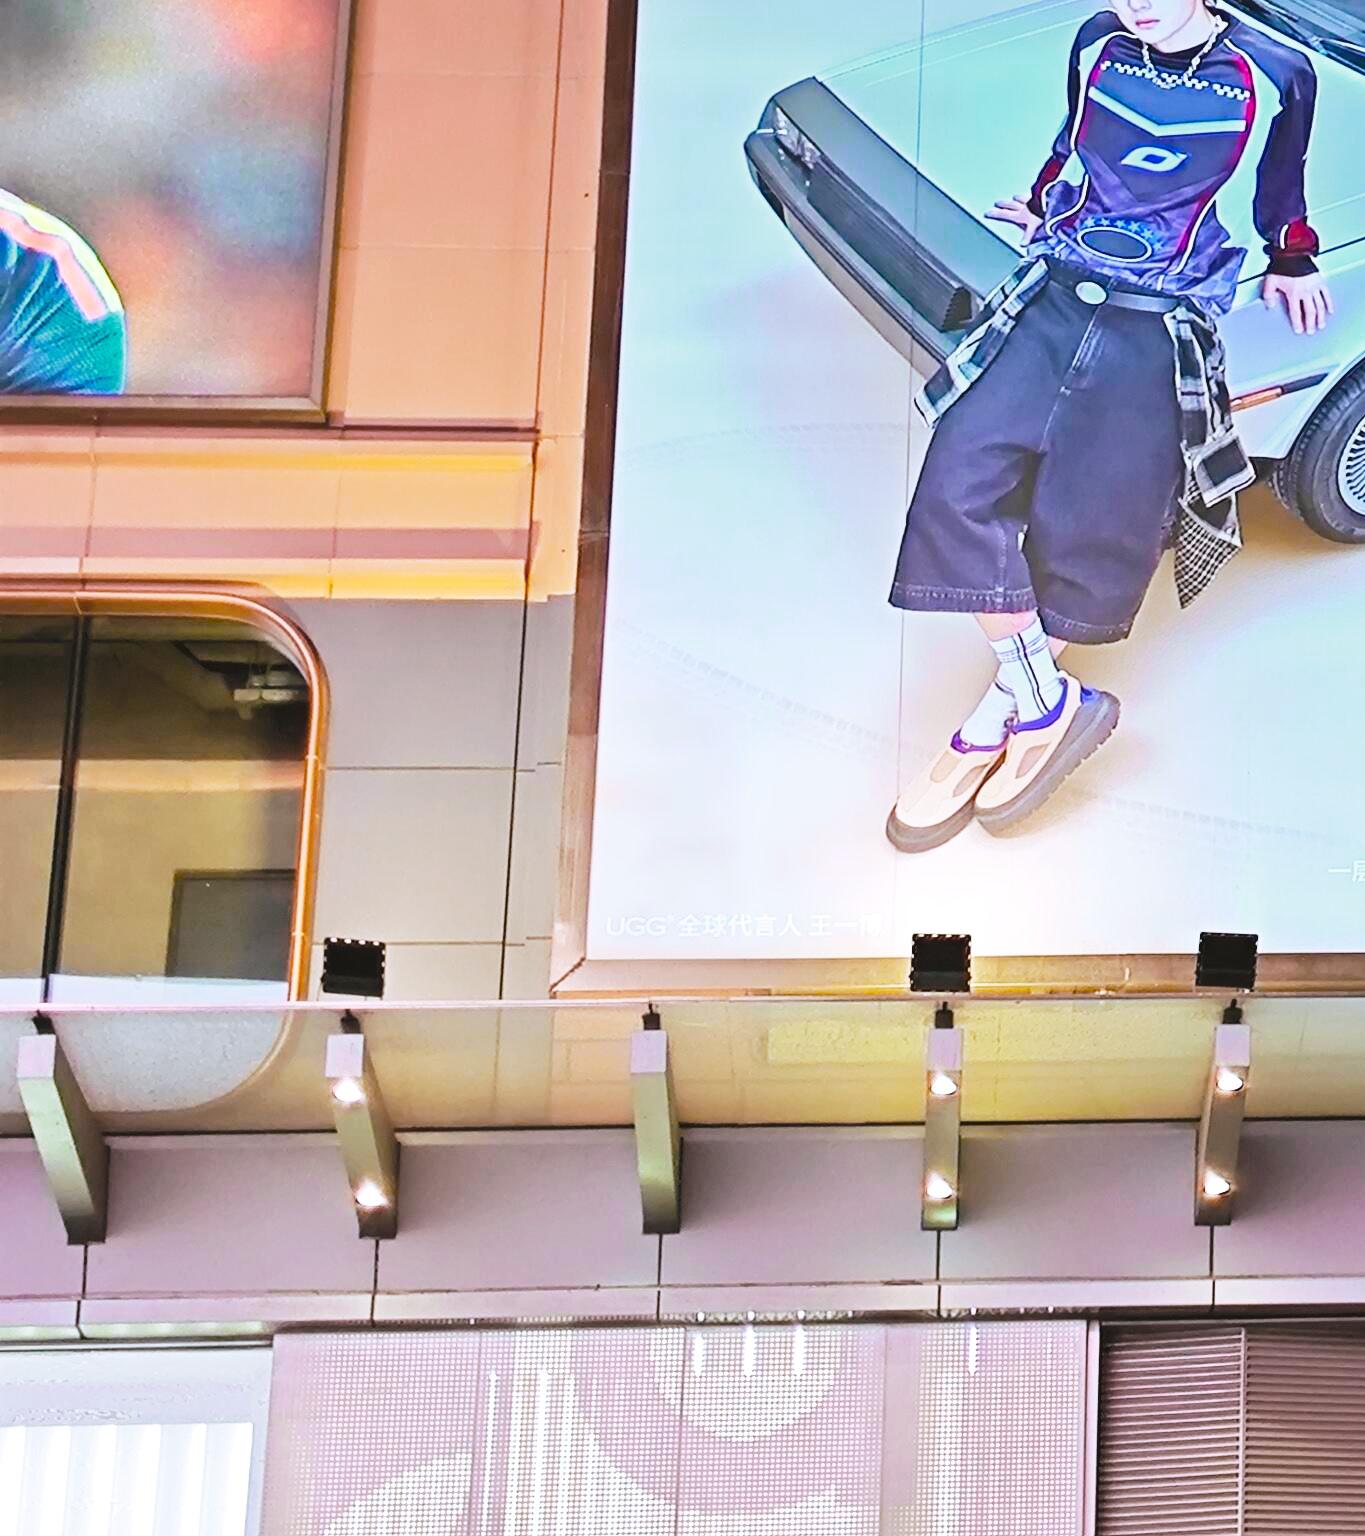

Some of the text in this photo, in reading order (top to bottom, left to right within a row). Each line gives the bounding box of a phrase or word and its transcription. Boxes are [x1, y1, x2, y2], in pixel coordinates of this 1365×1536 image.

[678, 913, 802, 937] 全球代言人
